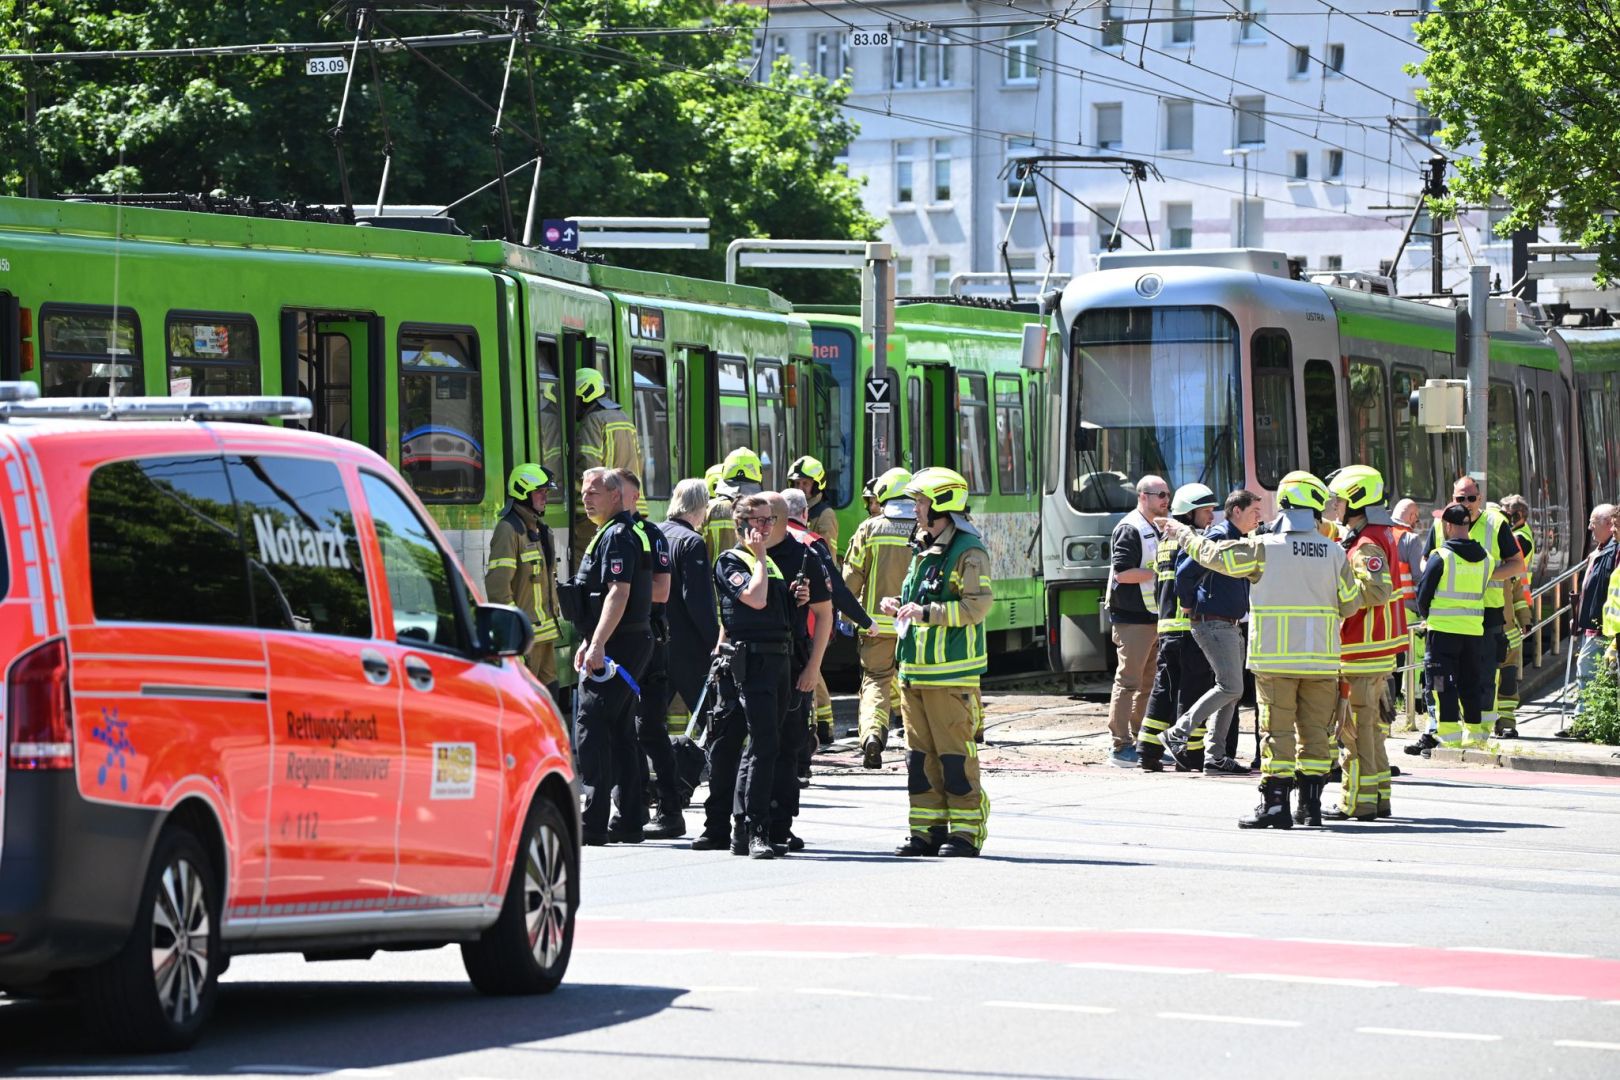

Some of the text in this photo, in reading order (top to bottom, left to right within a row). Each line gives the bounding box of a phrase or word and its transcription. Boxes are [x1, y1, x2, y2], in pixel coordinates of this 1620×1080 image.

[854, 33, 888, 46] 83.08
[310, 60, 344, 73] 83.09
[252, 512, 351, 570] Notarzt
[1292, 541, 1328, 558] B-DIENST
[286, 710, 379, 749] Rettungsdienst
[286, 752, 391, 788] Region Hannover
[297, 812, 319, 840] 112
